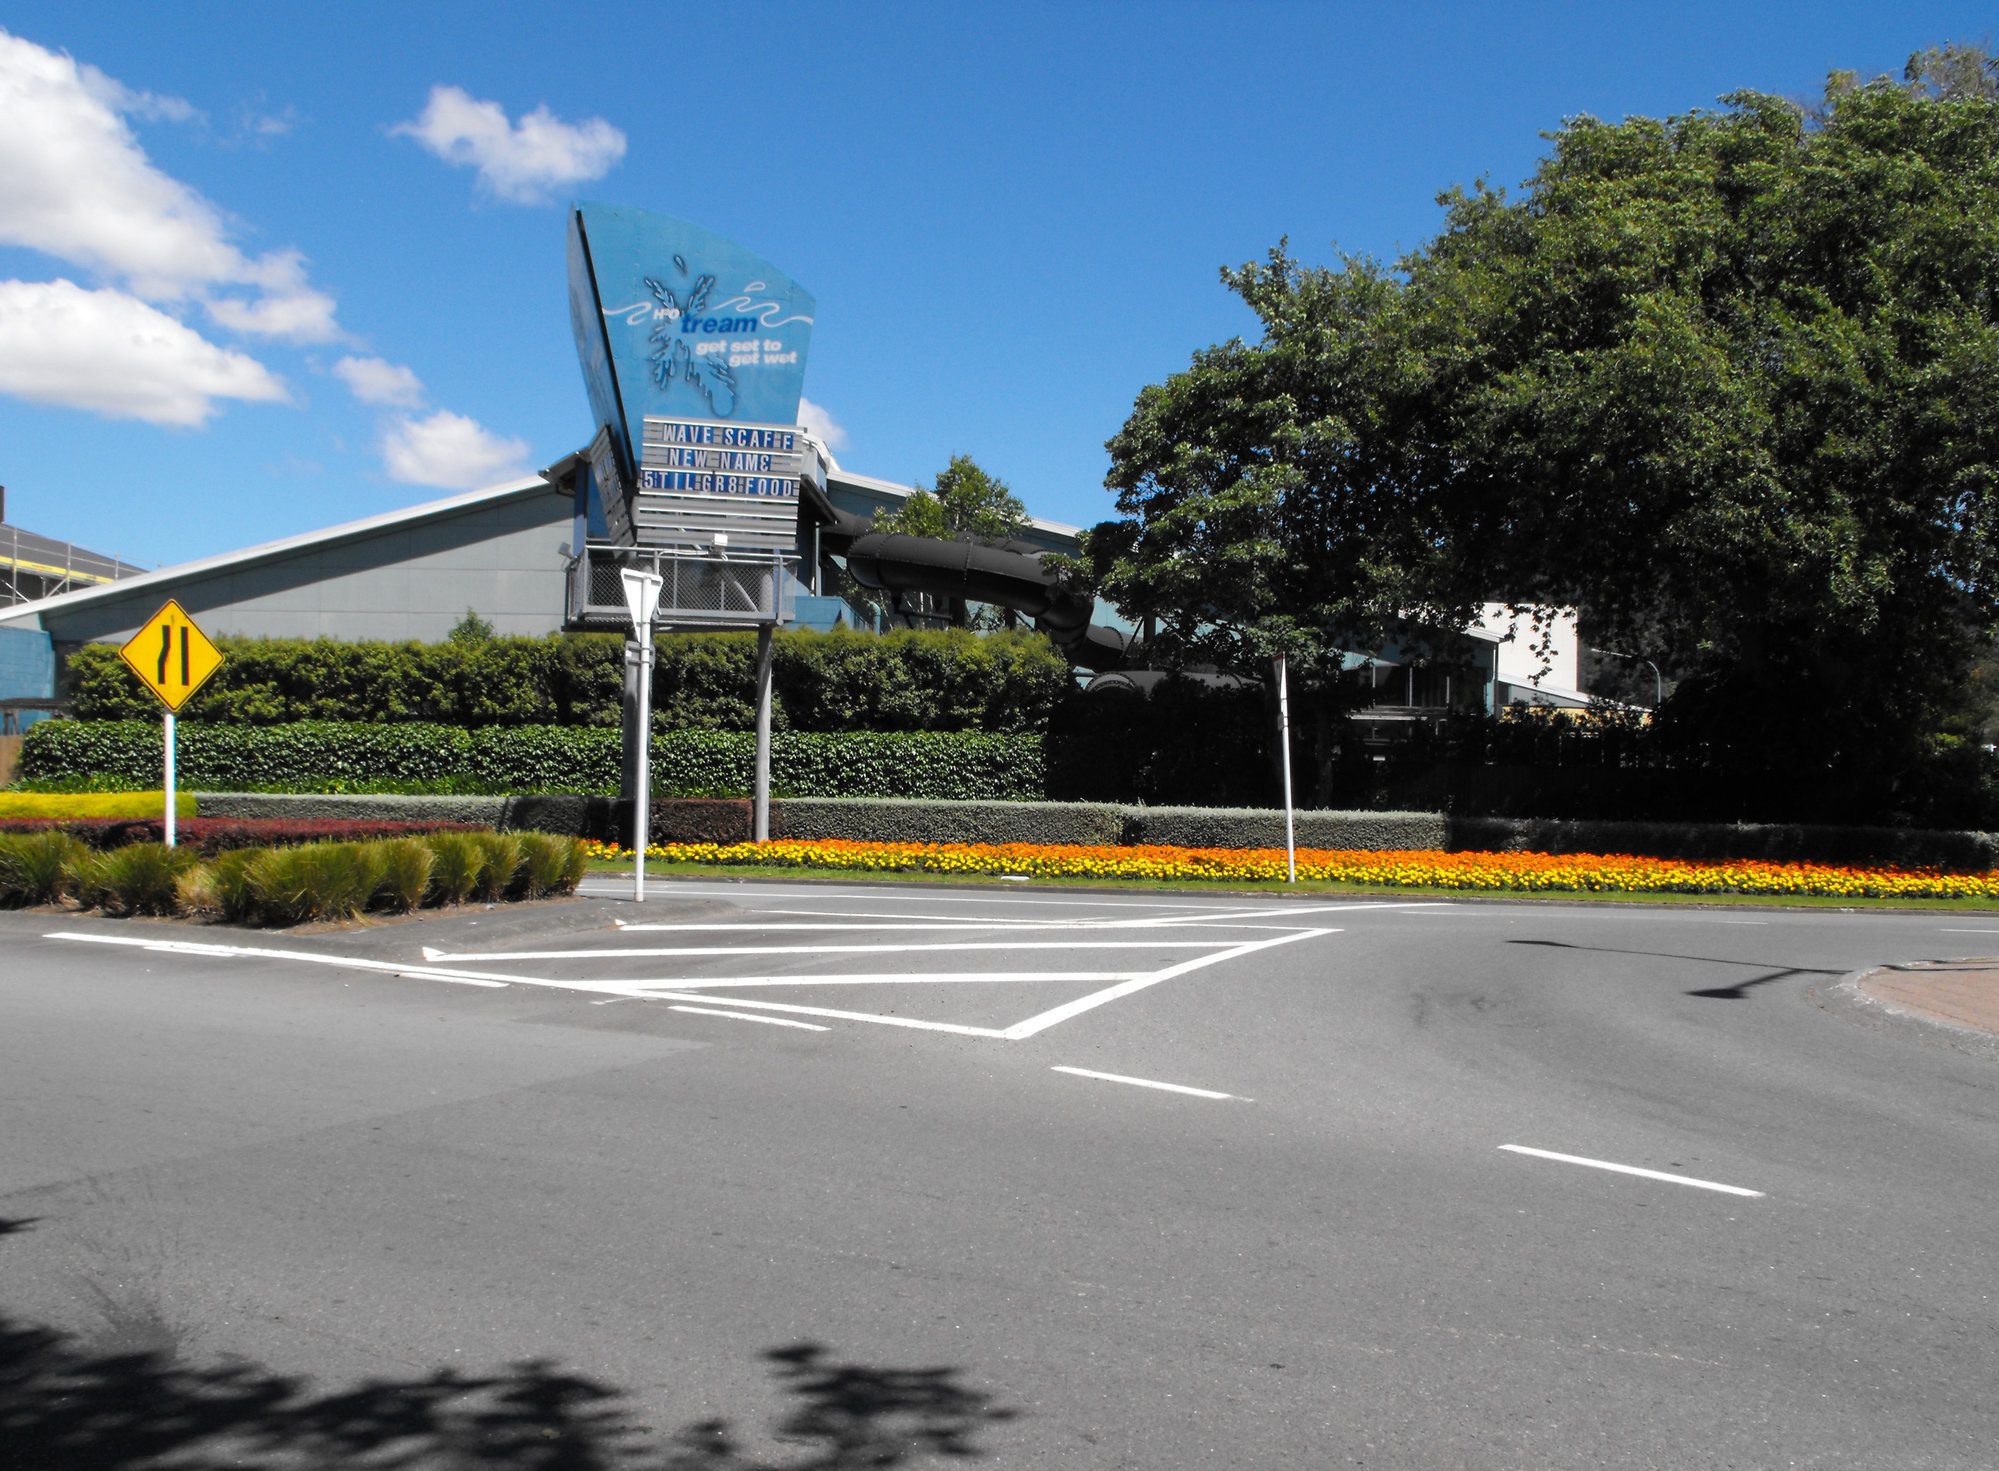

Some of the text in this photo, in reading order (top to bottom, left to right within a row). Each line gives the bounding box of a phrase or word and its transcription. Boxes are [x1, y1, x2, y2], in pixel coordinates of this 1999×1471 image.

[695, 340, 782, 355] get set to
[729, 351, 797, 367] get wet
[663, 424, 712, 444] WAVE
[669, 448, 770, 473] NEW NAME
[745, 478, 793, 497] FOOD
